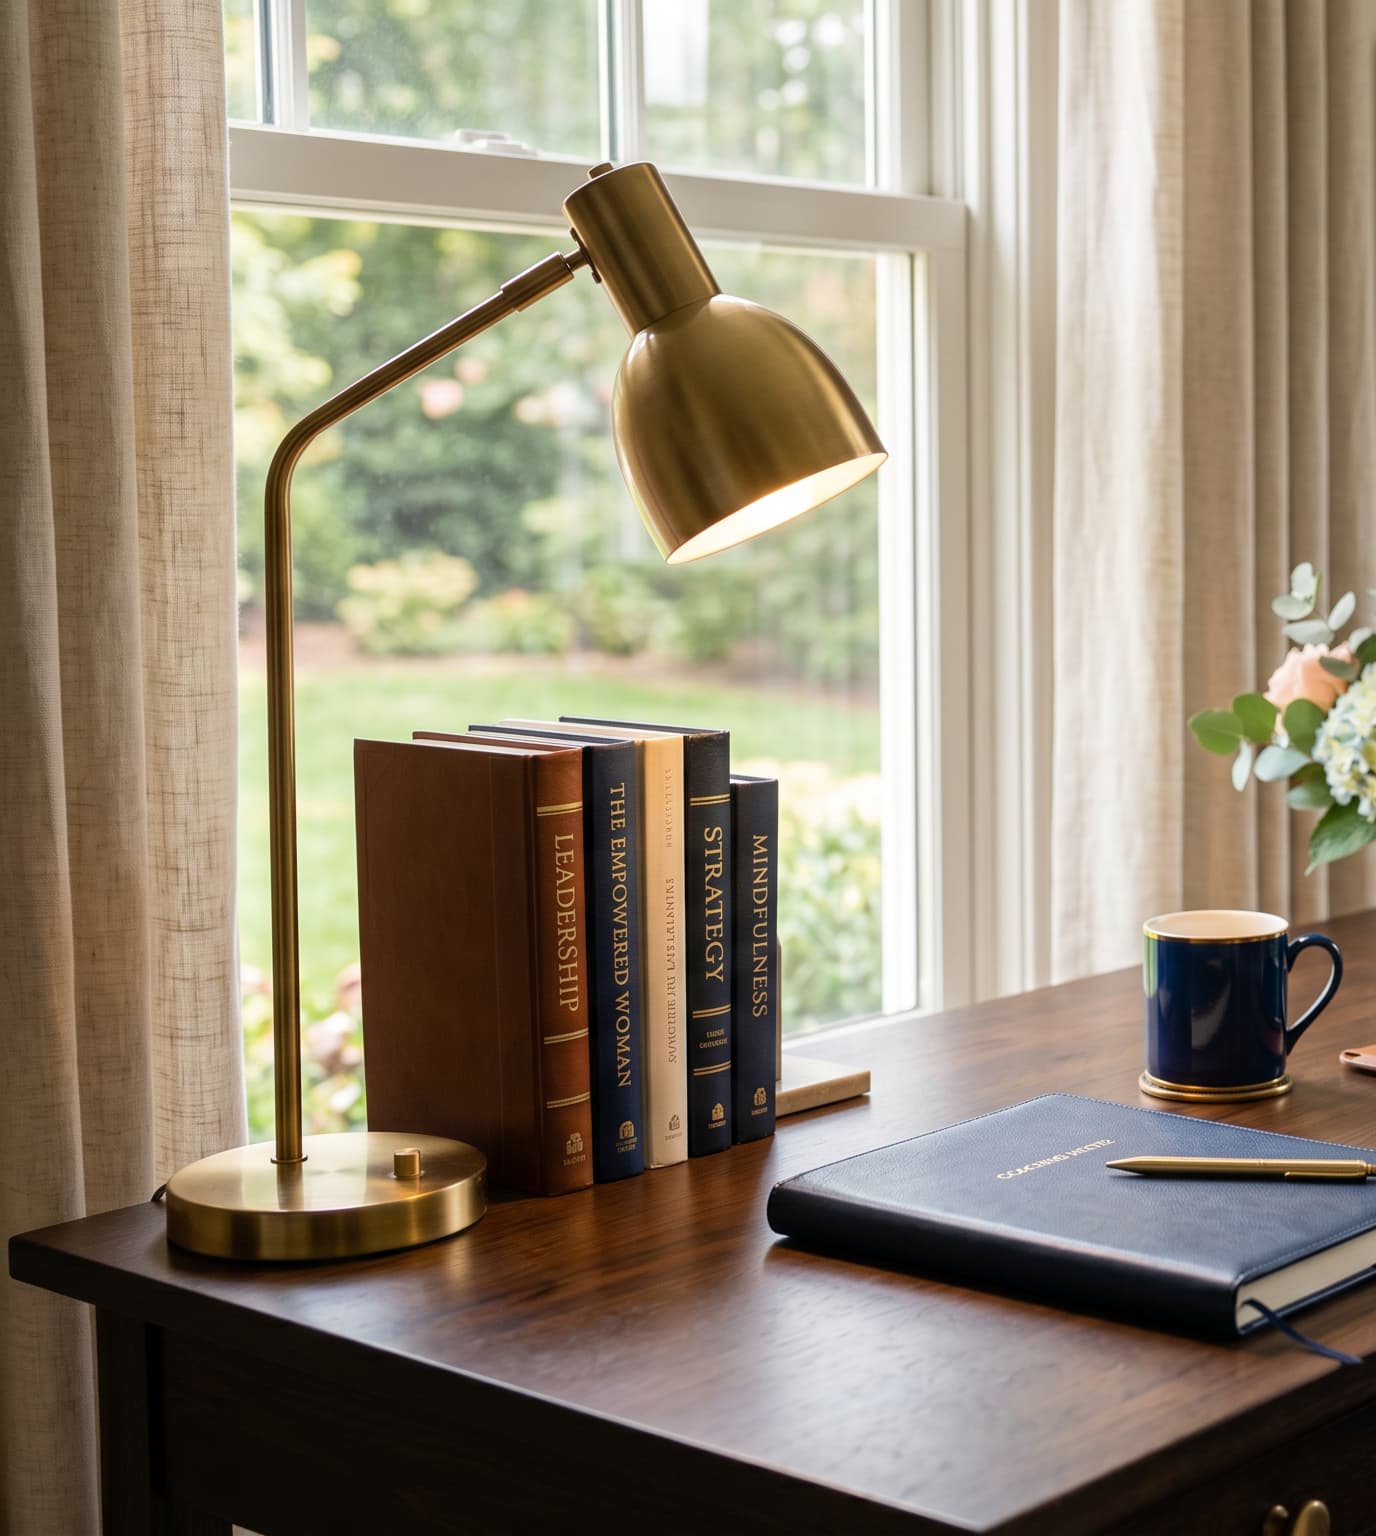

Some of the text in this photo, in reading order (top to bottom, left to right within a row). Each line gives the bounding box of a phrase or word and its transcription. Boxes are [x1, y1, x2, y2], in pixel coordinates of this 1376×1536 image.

[555, 833, 579, 1012] LEADERSHIP
[610, 783, 631, 1087] THE EMPOWERED WOMAN
[703, 826, 724, 983] STRATEGY
[752, 834, 769, 1018] MINDFULNESS
